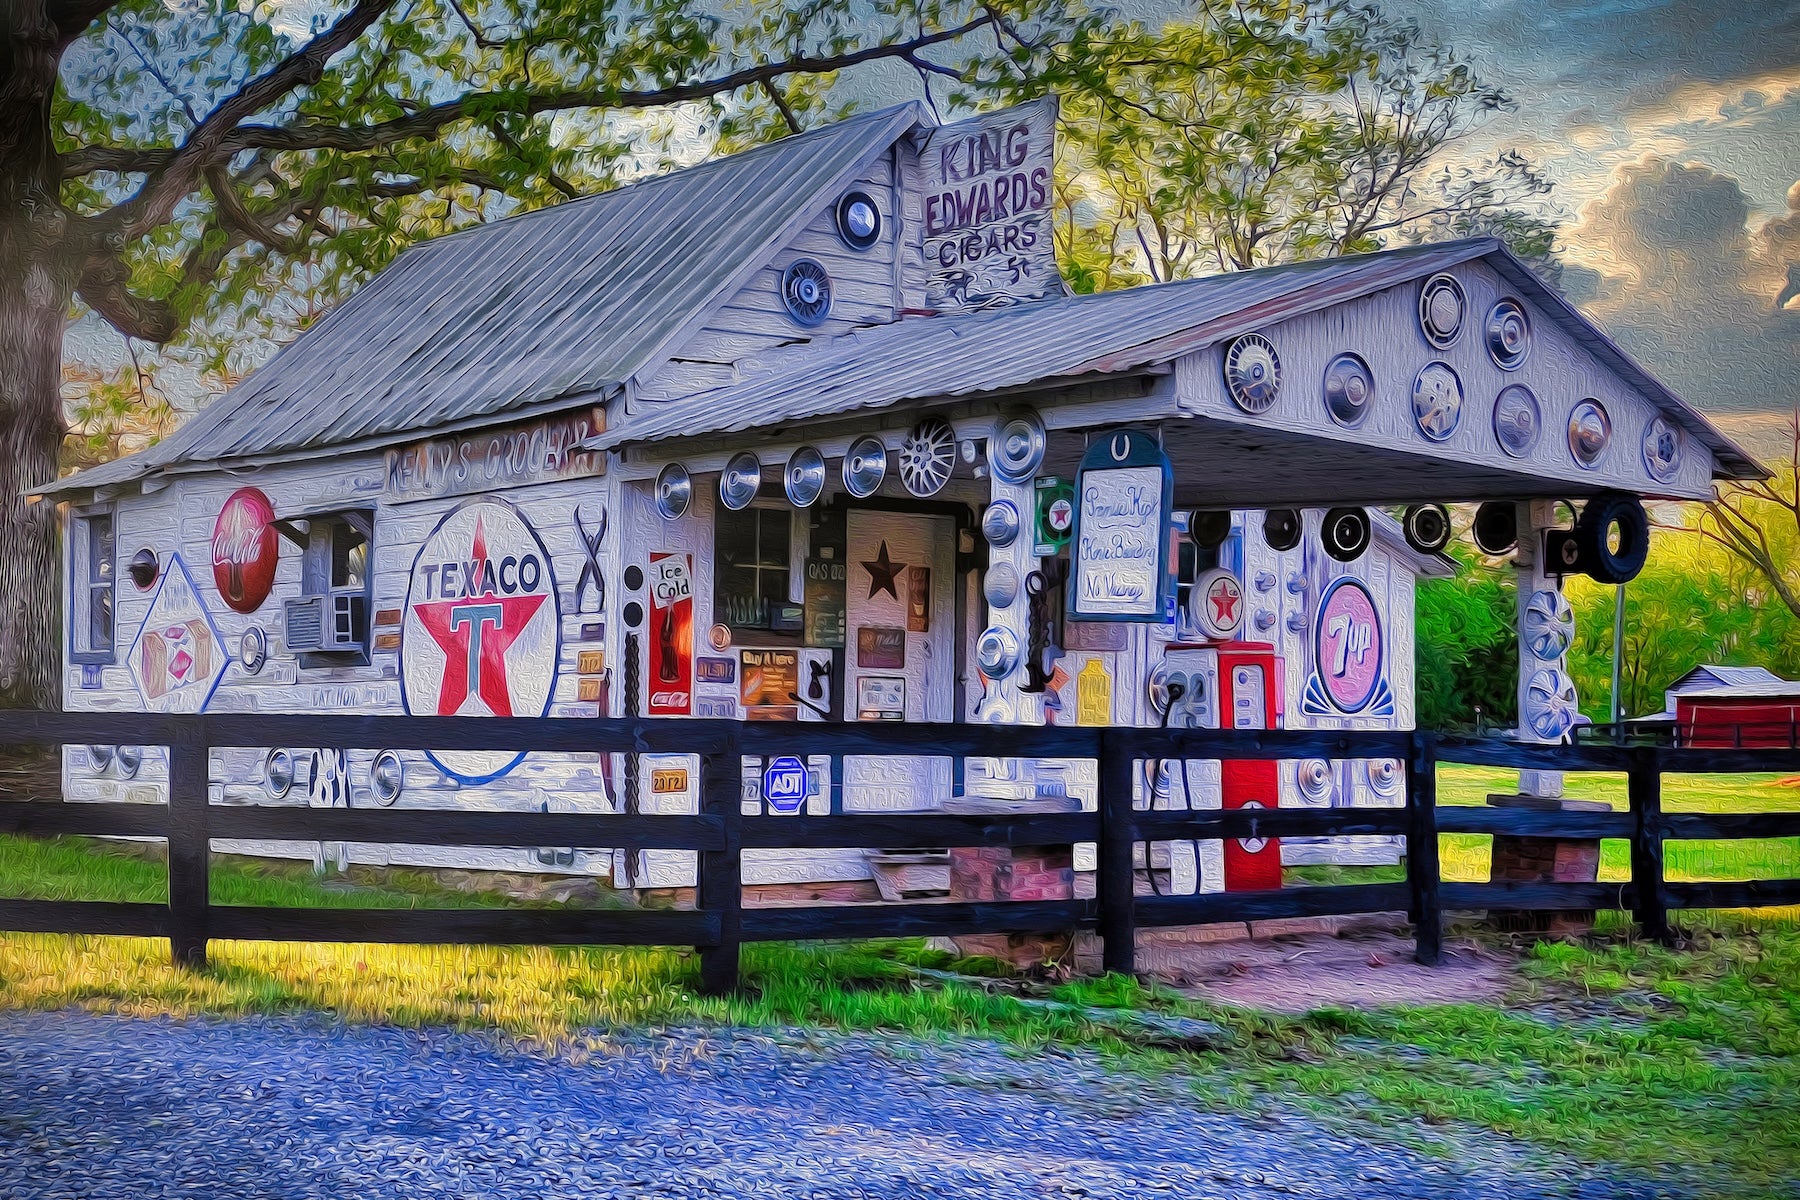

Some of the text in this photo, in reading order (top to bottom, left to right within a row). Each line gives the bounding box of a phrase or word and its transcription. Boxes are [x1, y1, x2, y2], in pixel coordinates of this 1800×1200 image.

[941, 125, 1029, 185] KING
[926, 167, 1047, 236] EDWARDS
[938, 221, 1037, 268] CIGARS
[420, 553, 541, 600] TEXACO
[659, 563, 684, 580] Ice
[656, 579, 690, 600] Cold
[742, 651, 763, 667] Buy
[772, 651, 795, 665] here
[771, 772, 801, 795] ADT
